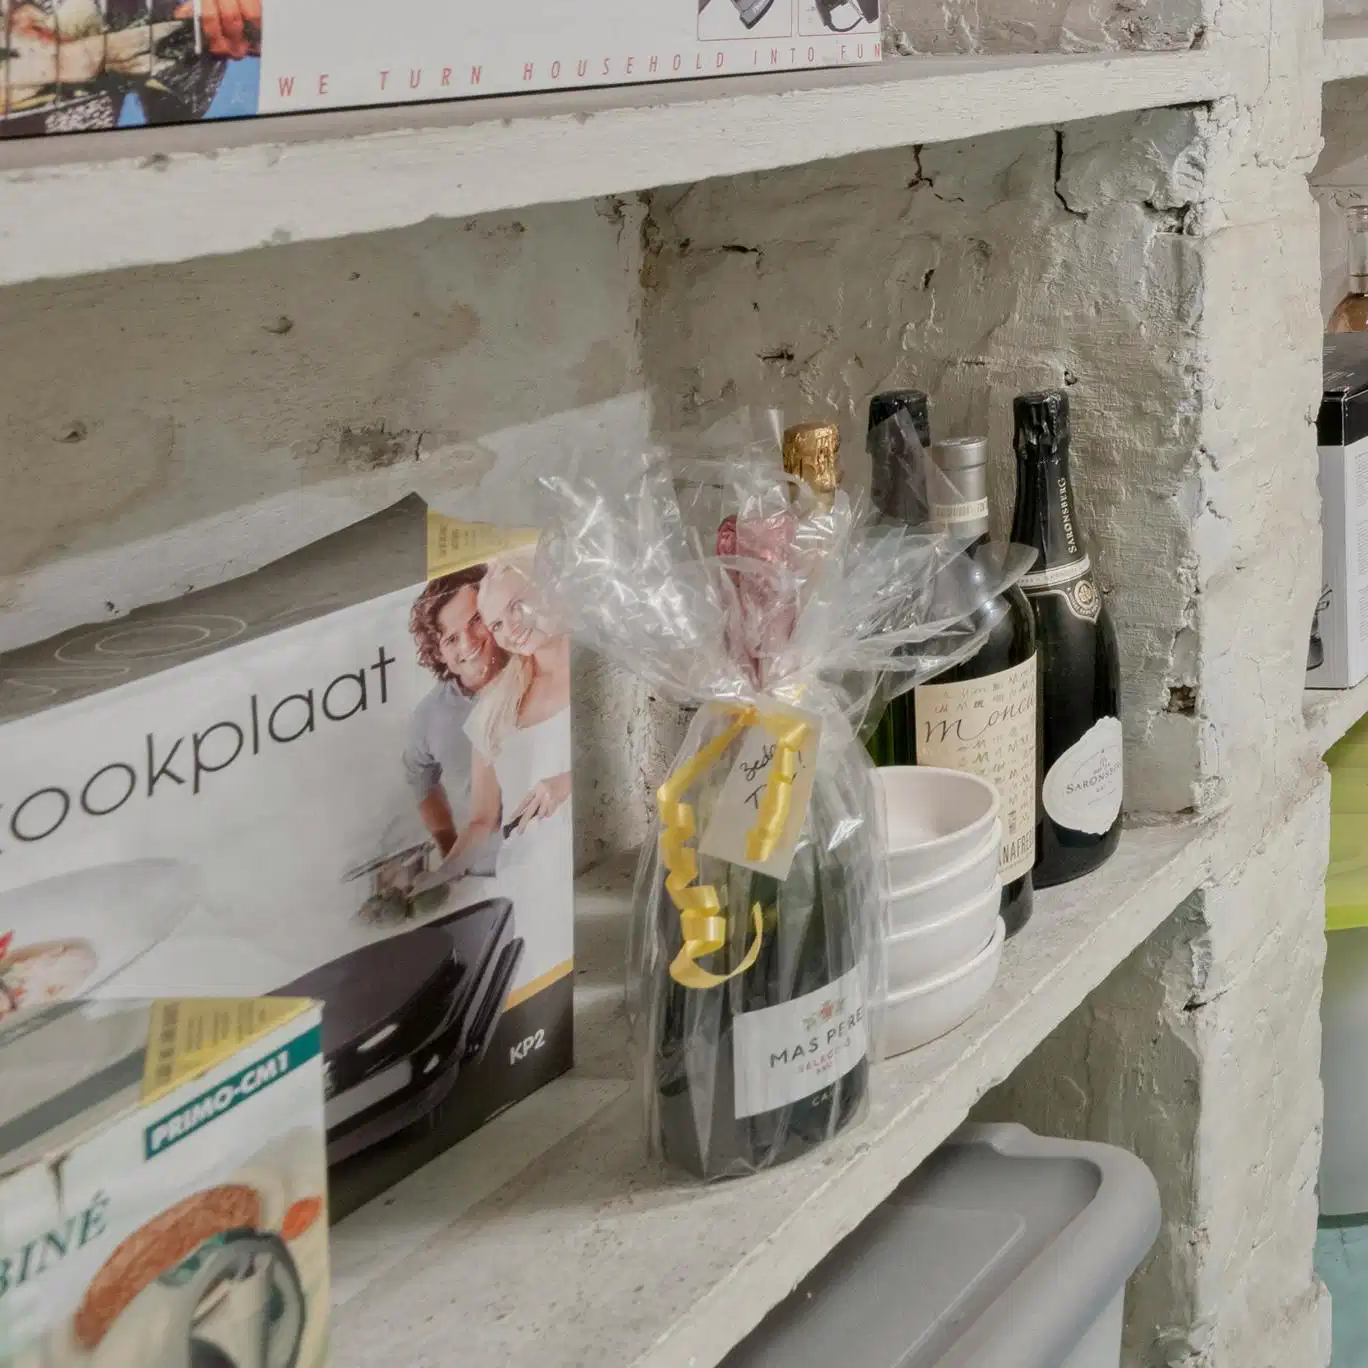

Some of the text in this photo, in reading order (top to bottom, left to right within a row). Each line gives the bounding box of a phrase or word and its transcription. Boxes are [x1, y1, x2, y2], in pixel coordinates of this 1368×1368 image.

[278, 43, 881, 97] WE TURN HOUSEHOLD INTO FUN
[0, 646, 397, 854] ookplaat
[510, 1028, 546, 1065] KP2
[769, 1037, 819, 1069] MAS
[150, 1050, 290, 1151] PRIMO-CM1
